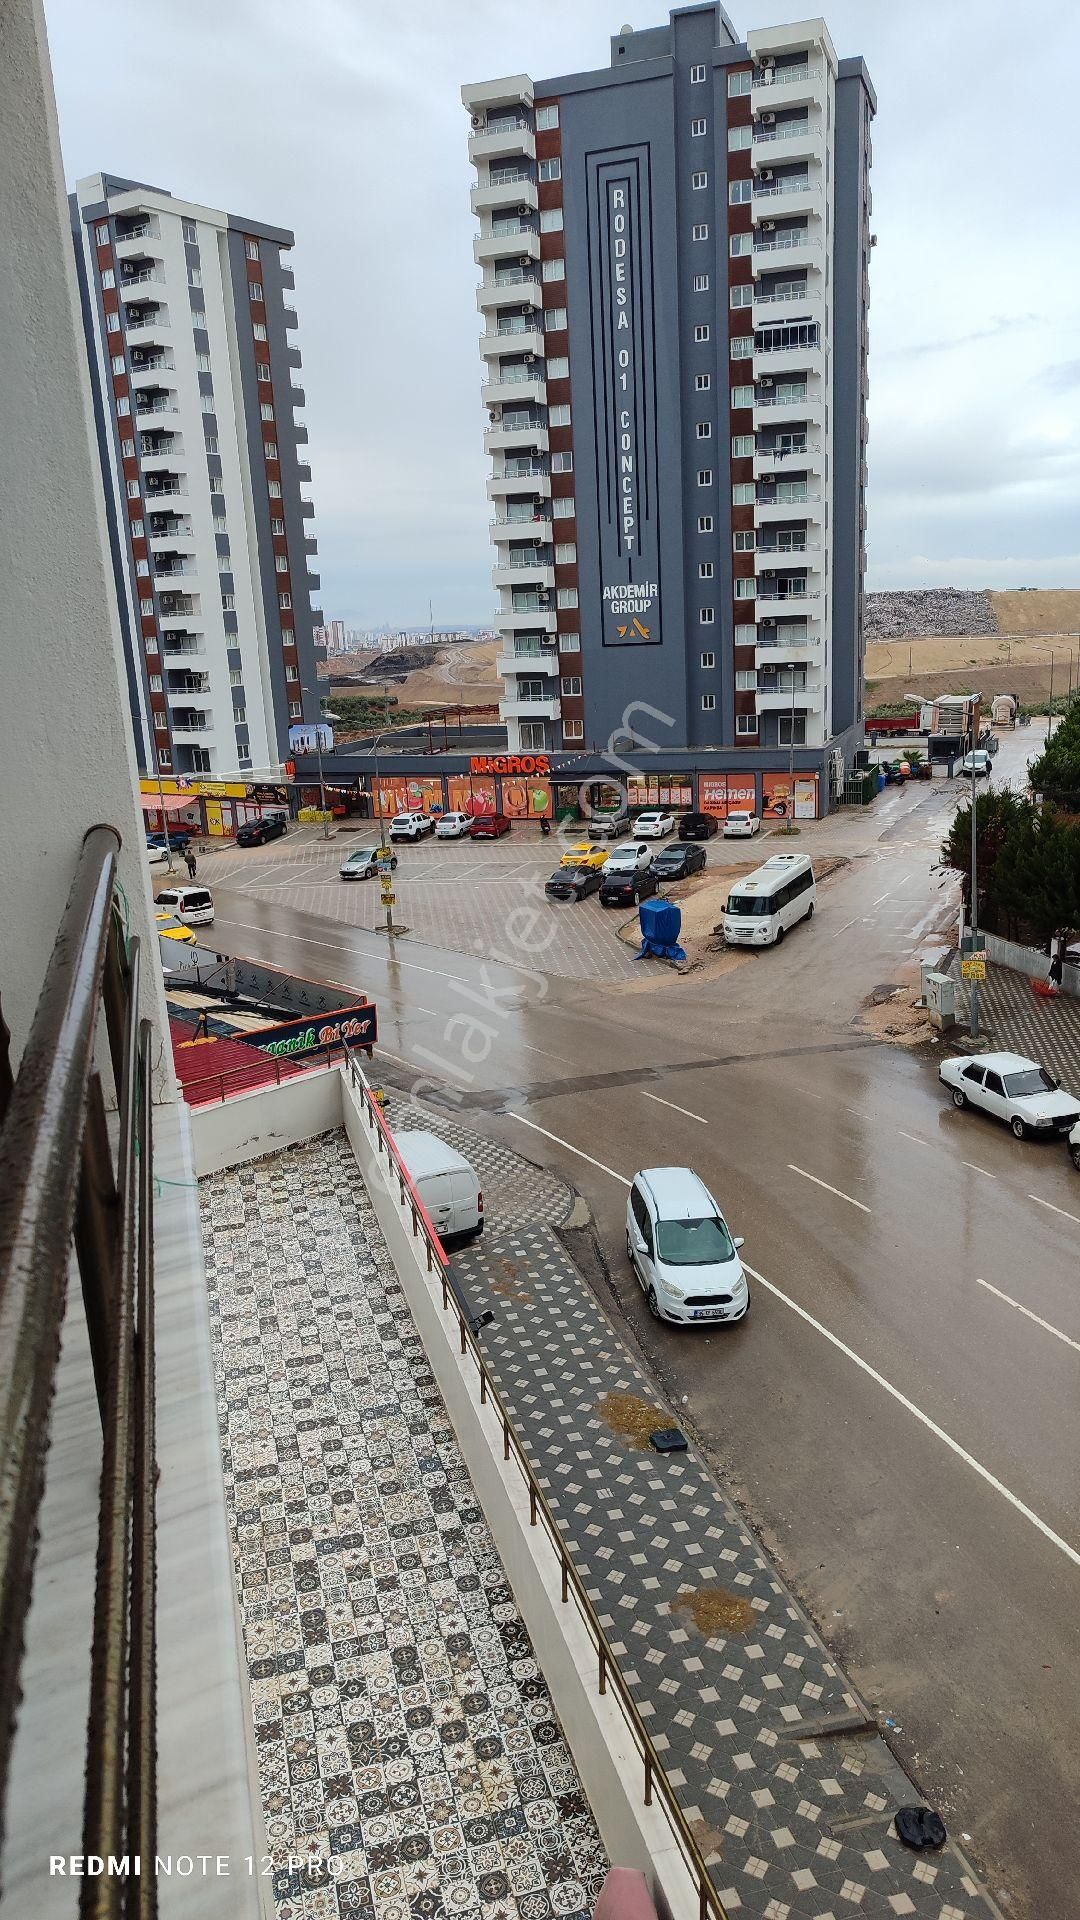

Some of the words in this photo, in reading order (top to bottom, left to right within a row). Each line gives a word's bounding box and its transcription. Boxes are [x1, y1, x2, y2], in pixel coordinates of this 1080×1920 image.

[613, 189, 629, 330] RODESA
[620, 410, 635, 550] CONCEPT
[602, 581, 658, 600] AKDEMİR
[611, 599, 652, 614] GROUP
[704, 789, 755, 800] Hemen
[319, 1022, 341, 1044] Bi
[341, 1017, 371, 1039] Yer
